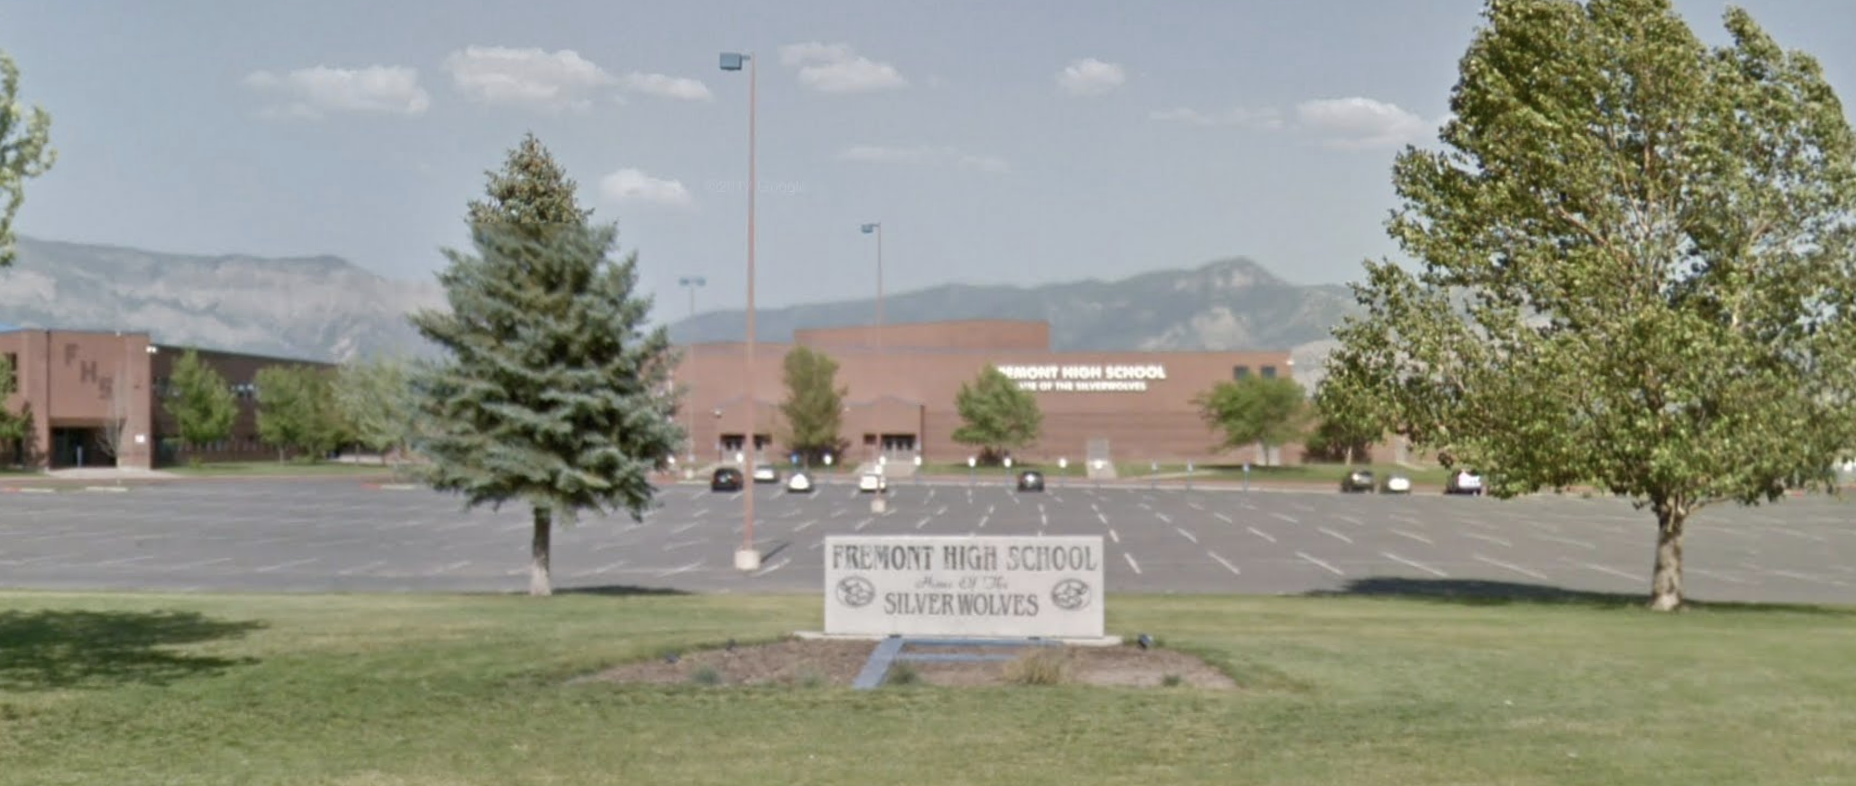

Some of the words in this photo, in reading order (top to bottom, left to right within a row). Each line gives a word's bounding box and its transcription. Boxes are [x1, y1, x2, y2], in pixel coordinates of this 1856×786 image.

[997, 365, 1058, 380] EMONT
[1061, 365, 1102, 380] HIGH
[1105, 365, 1167, 380] SCHOOL
[1039, 381, 1052, 391] OF
[1055, 381, 1073, 391] THE
[1075, 381, 1148, 391] SILVERWOLVES
[832, 544, 934, 571] FREMONT
[943, 545, 997, 571] HIGH
[1006, 546, 1098, 572] SCHOOL
